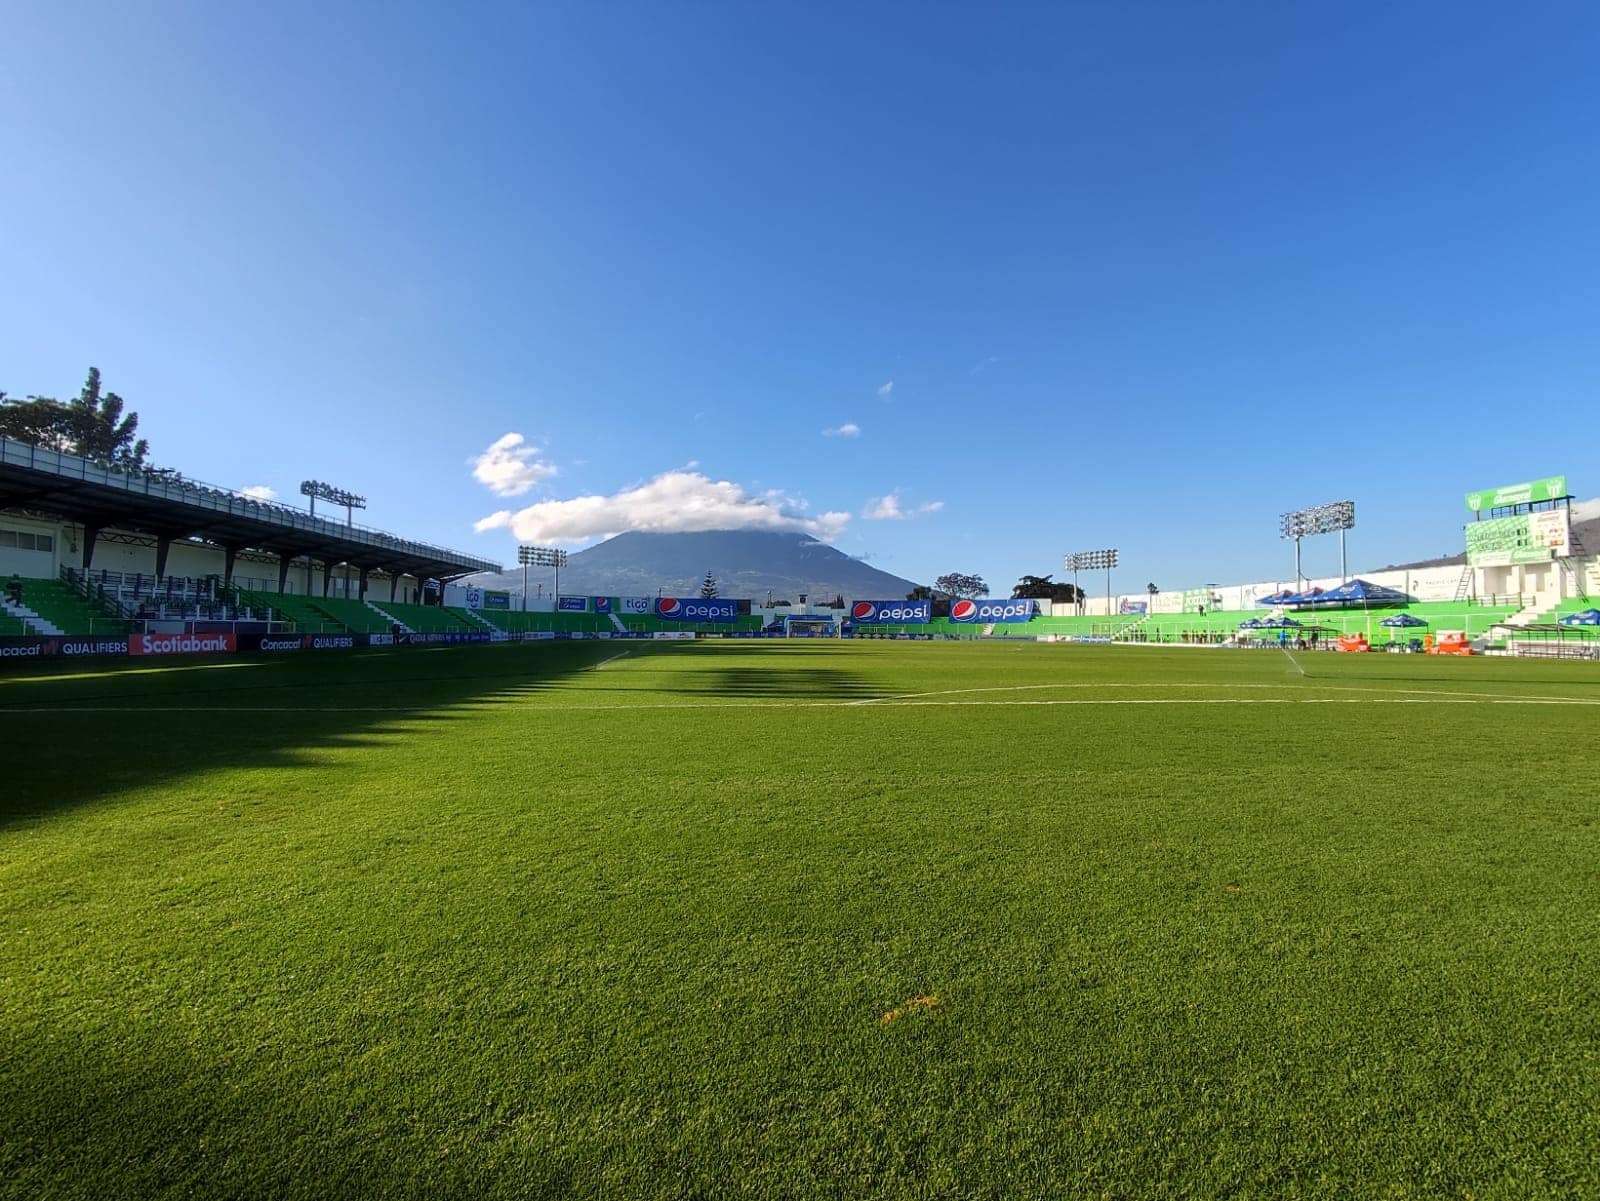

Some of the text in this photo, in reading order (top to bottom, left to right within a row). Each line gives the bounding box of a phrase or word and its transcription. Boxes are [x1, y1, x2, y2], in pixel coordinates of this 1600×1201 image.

[626, 598, 648, 613] tigo
[686, 605, 734, 618] pepsi
[879, 605, 928, 620] pepsi
[980, 602, 1030, 619] pepsi
[63, 642, 128, 654] QUALIFIERS
[142, 635, 228, 653] Scotiabank
[260, 637, 353, 650] Concacaf QUALIFIERS
